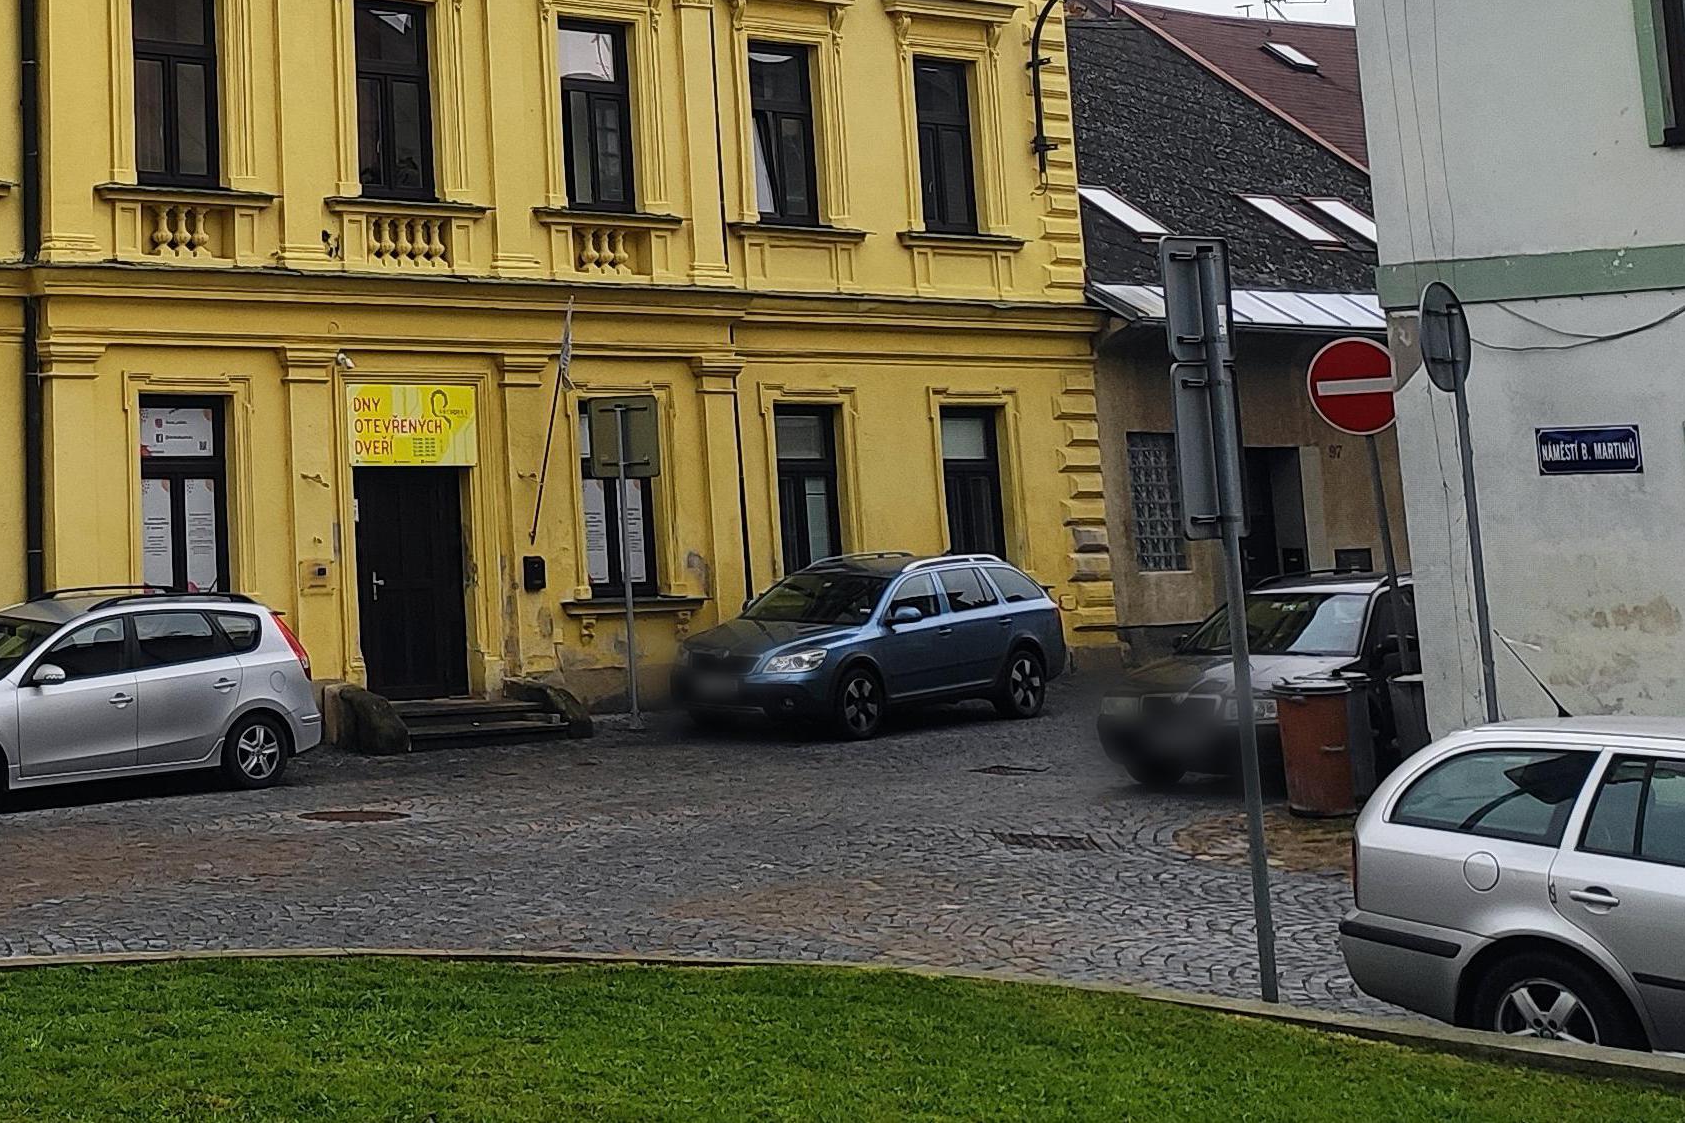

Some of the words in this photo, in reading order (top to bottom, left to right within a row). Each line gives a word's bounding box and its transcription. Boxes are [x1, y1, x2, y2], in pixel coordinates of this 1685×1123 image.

[353, 396, 381, 413] DNY
[354, 414, 443, 434] OTEVŘENÝCH
[355, 435, 394, 456] DVEŘÍ
[1328, 444, 1343, 459] 97
[1542, 439, 1579, 461] NÁMĚSTÍ
[1581, 444, 1592, 460] B.
[1594, 437, 1636, 460] MARTINŮ
